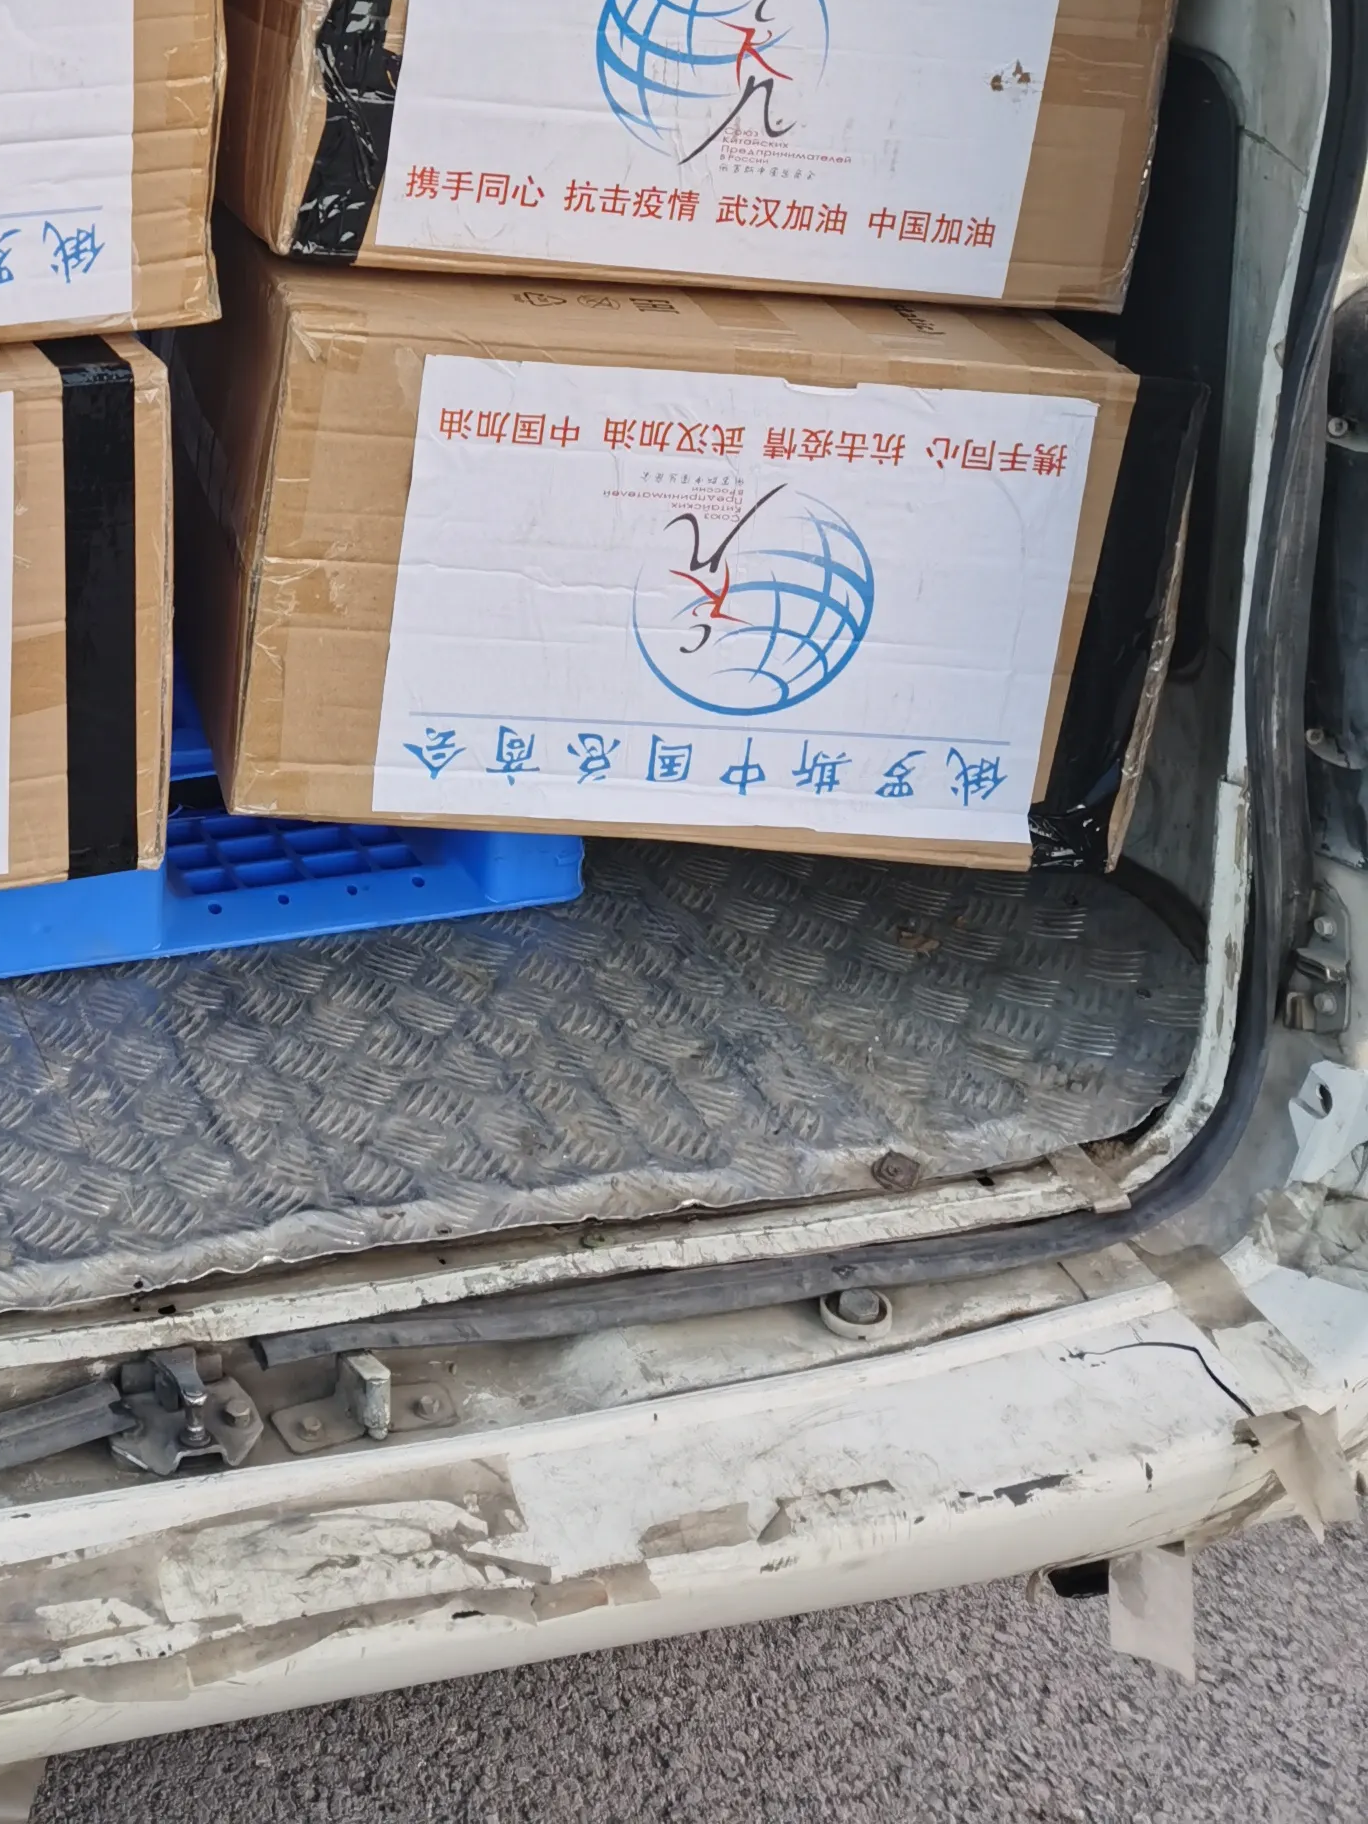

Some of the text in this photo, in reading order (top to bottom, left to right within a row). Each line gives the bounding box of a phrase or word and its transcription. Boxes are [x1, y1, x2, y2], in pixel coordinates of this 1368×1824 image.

[406, 165, 995, 248] 携手同心 抗击疫情 武汉加油 中国加油
[439, 407, 1067, 476] 携手同心 抗击疫情 武汉加油 中国加油
[704, 513, 740, 523] Союз
[403, 725, 1008, 808] 俄罗斯中国总商会
